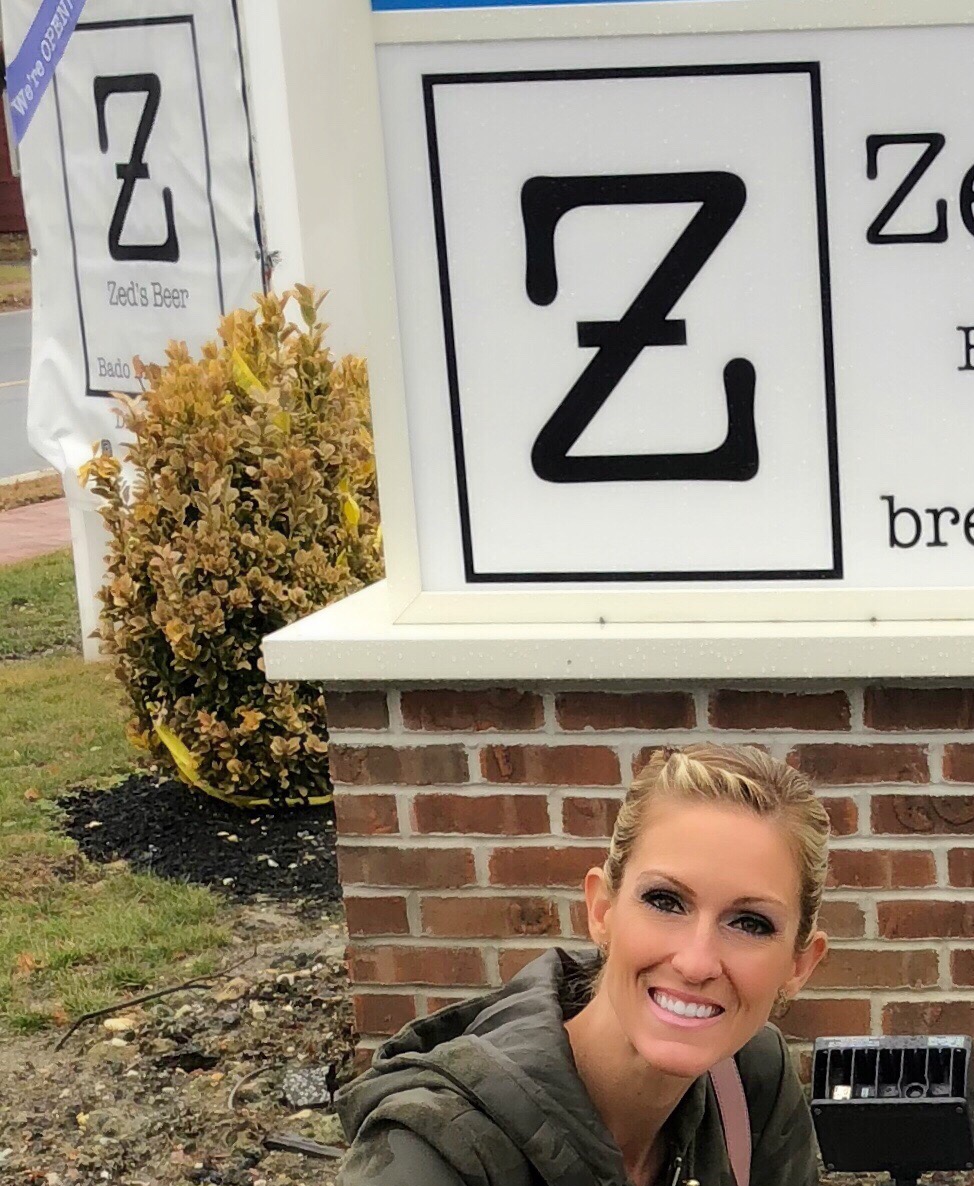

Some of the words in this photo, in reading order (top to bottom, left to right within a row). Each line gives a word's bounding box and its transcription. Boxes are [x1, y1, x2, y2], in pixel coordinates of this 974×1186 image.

[10, 60, 46, 116] We're
[94, 73, 179, 262] Z
[107, 280, 149, 308] Zed's
[150, 281, 190, 309] Beer
[520, 170, 760, 484] Z
[97, 356, 131, 379] Bado
